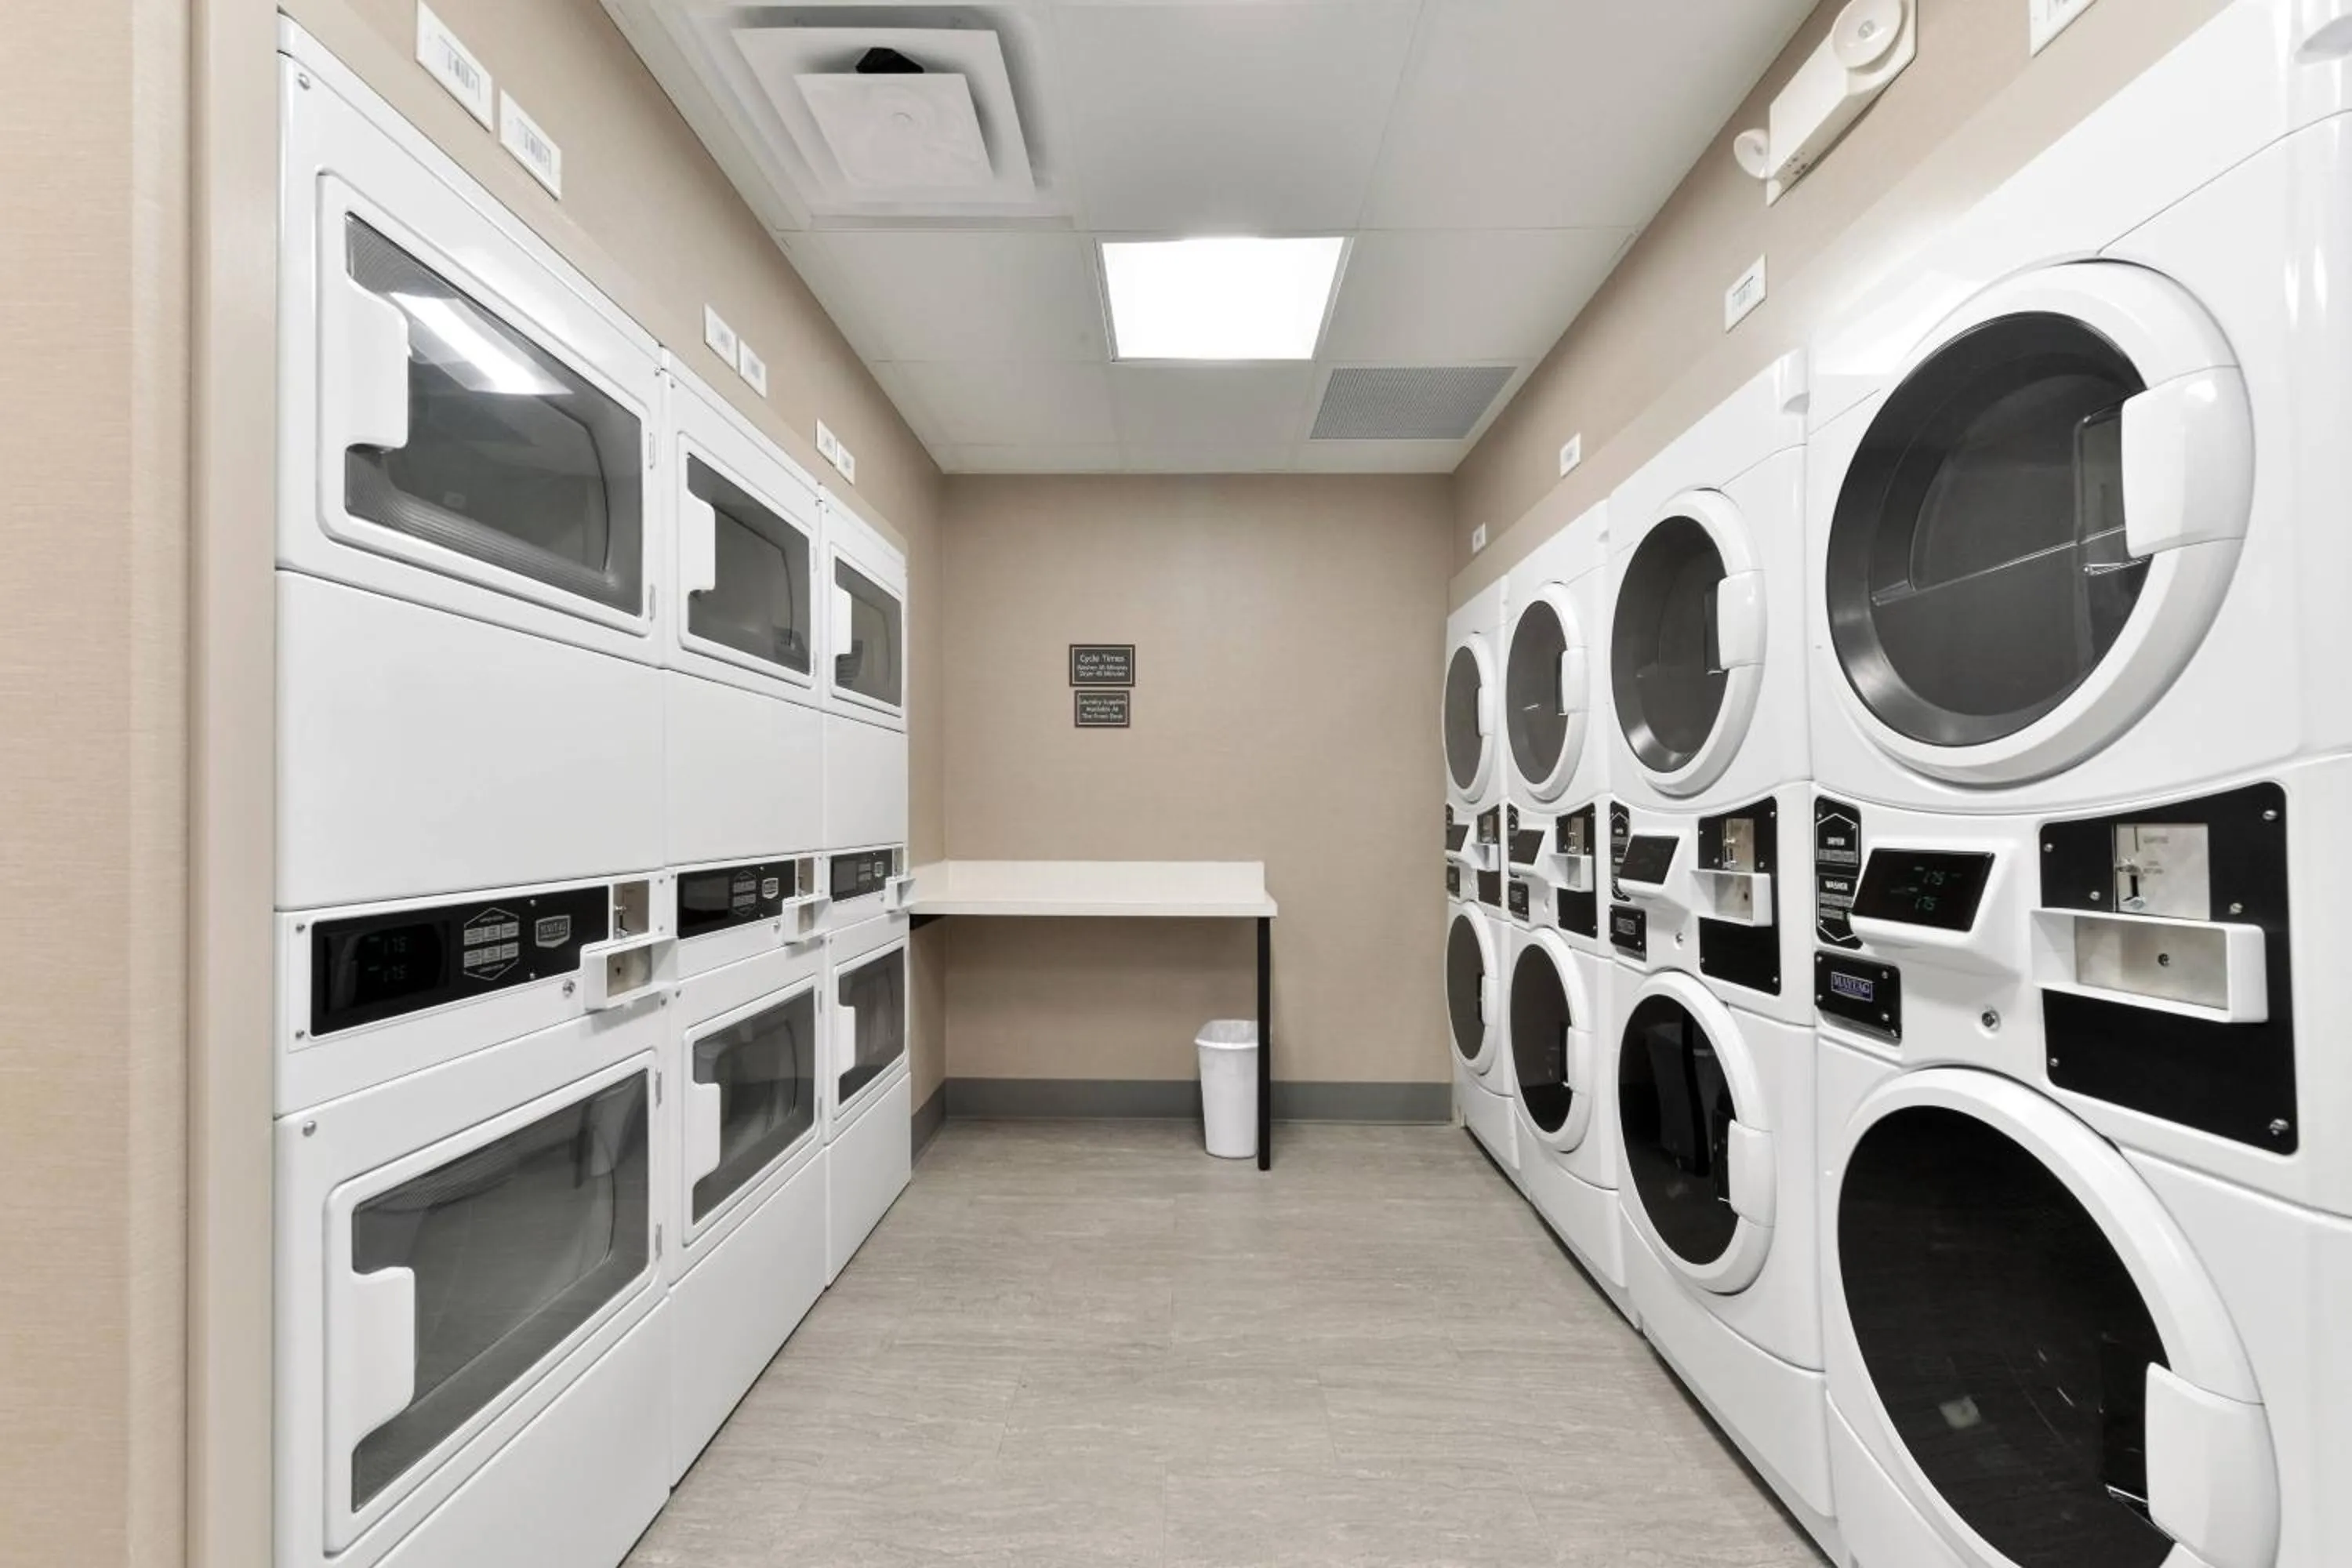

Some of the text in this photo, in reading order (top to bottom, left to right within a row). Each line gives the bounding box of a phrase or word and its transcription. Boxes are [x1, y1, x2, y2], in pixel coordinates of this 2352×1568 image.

[1080, 653, 1125, 663] Cycle Times
[1824, 880, 1848, 891] WASHER
